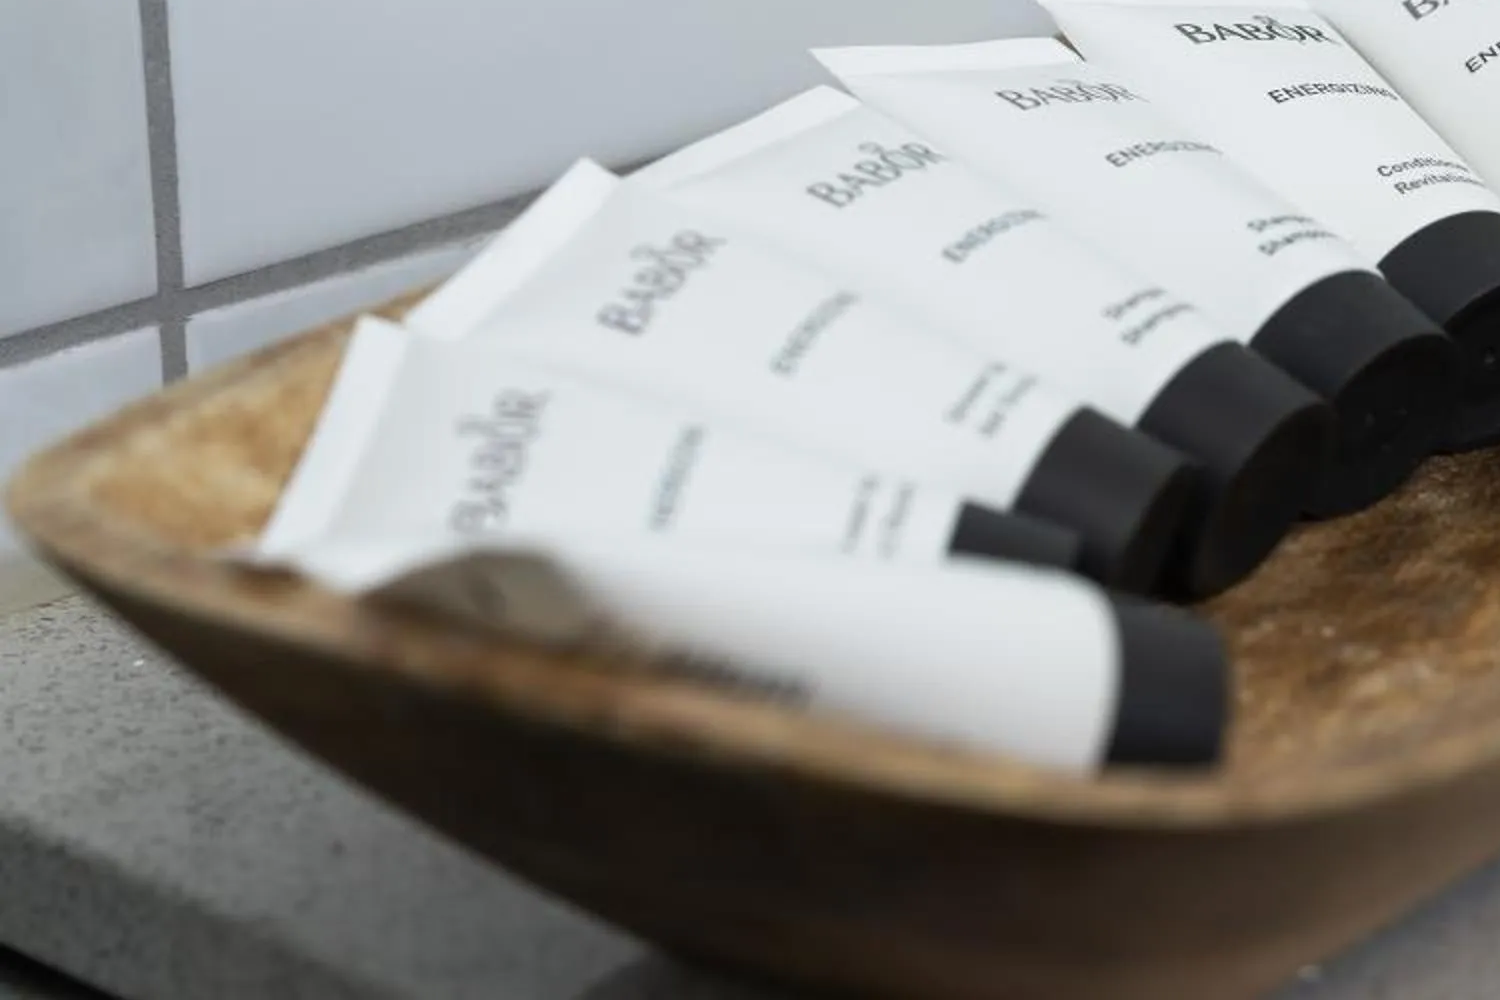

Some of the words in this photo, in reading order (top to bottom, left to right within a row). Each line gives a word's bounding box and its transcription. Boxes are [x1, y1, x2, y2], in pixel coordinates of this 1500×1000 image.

[1174, 16, 1343, 45] BABOR
[805, 141, 950, 208] BABOR
[1377, 158, 1470, 177] Conditio
[1393, 175, 1488, 195] Revitalis
